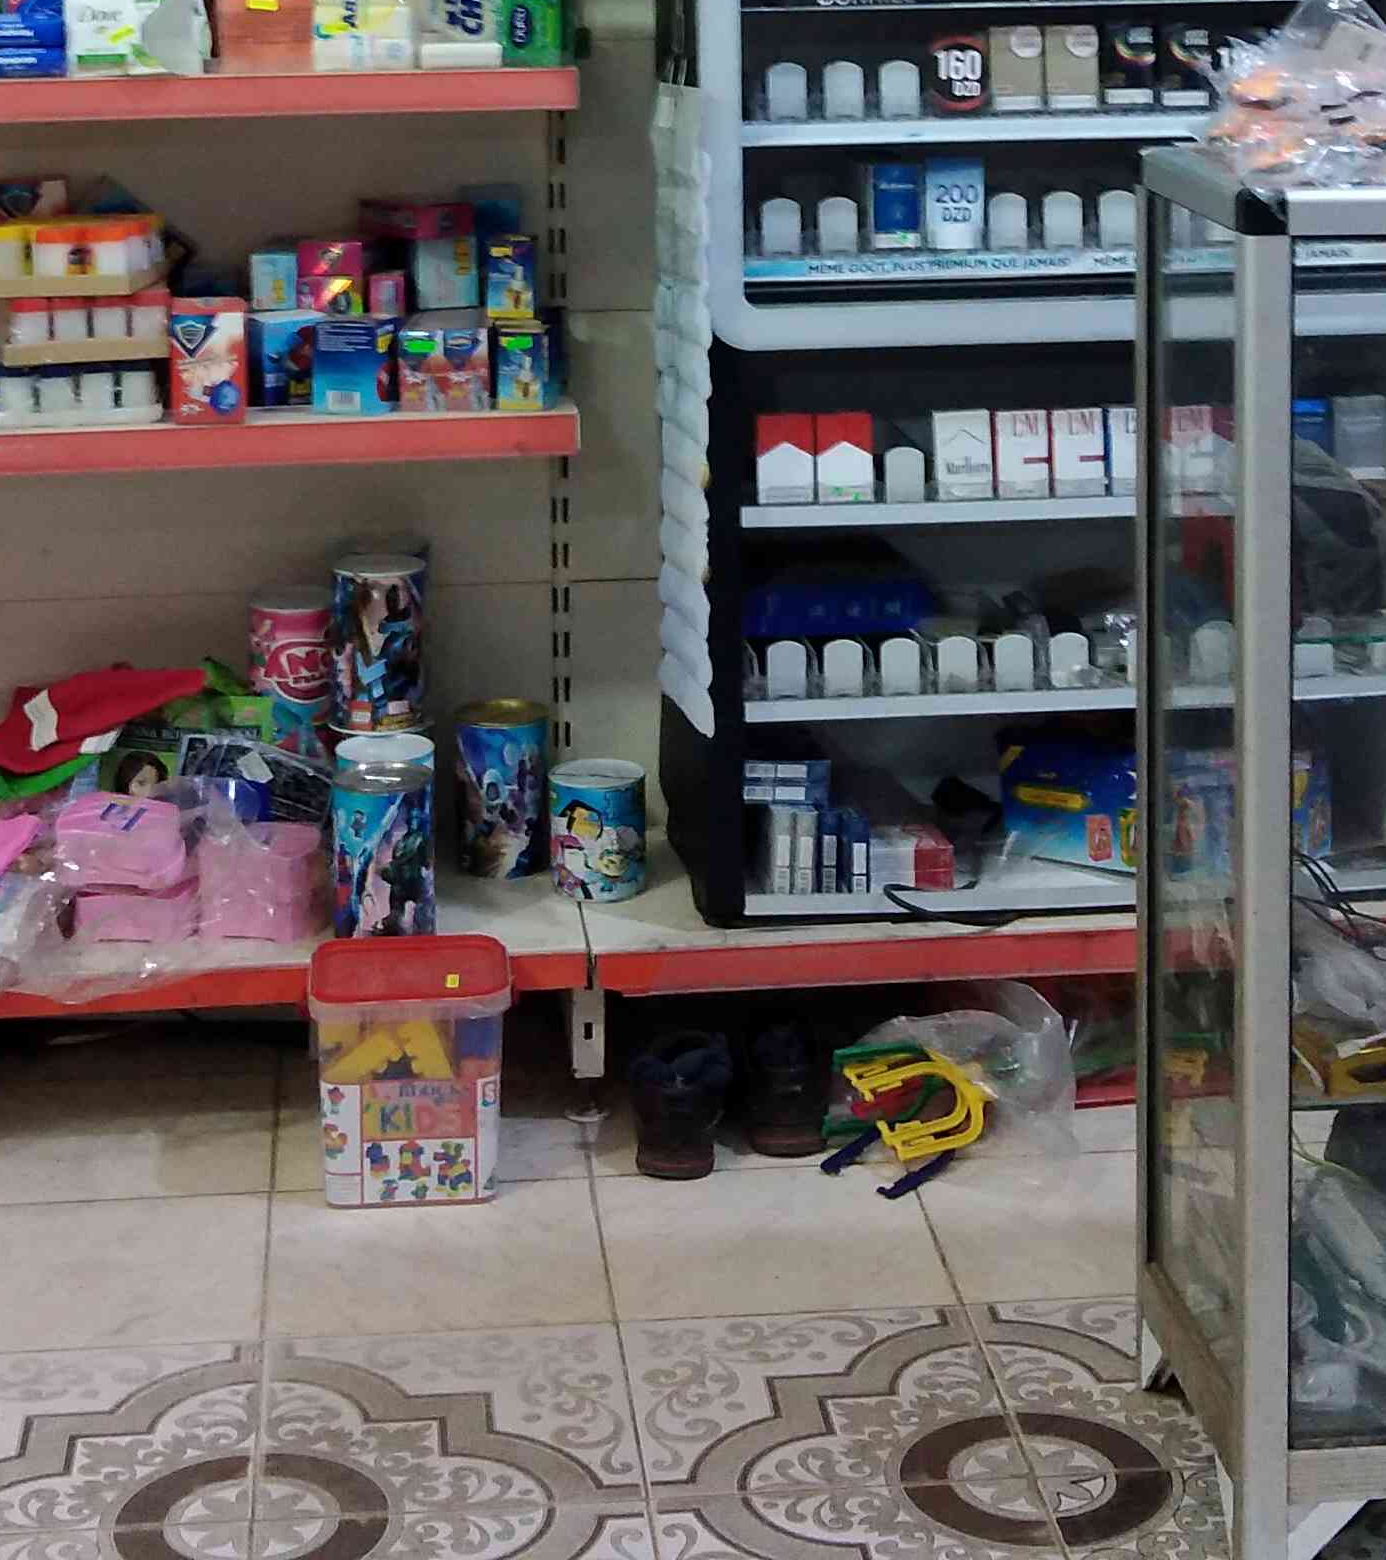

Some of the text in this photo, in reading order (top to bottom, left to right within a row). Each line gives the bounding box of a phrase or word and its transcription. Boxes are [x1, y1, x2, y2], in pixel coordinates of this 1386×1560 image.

[933, 49, 982, 81] 160
[951, 81, 982, 97] DZD
[935, 183, 980, 205] 200
[940, 206, 973, 223] DZD
[991, 255, 1020, 270] QUE
[945, 460, 992, 475] Marlboro
